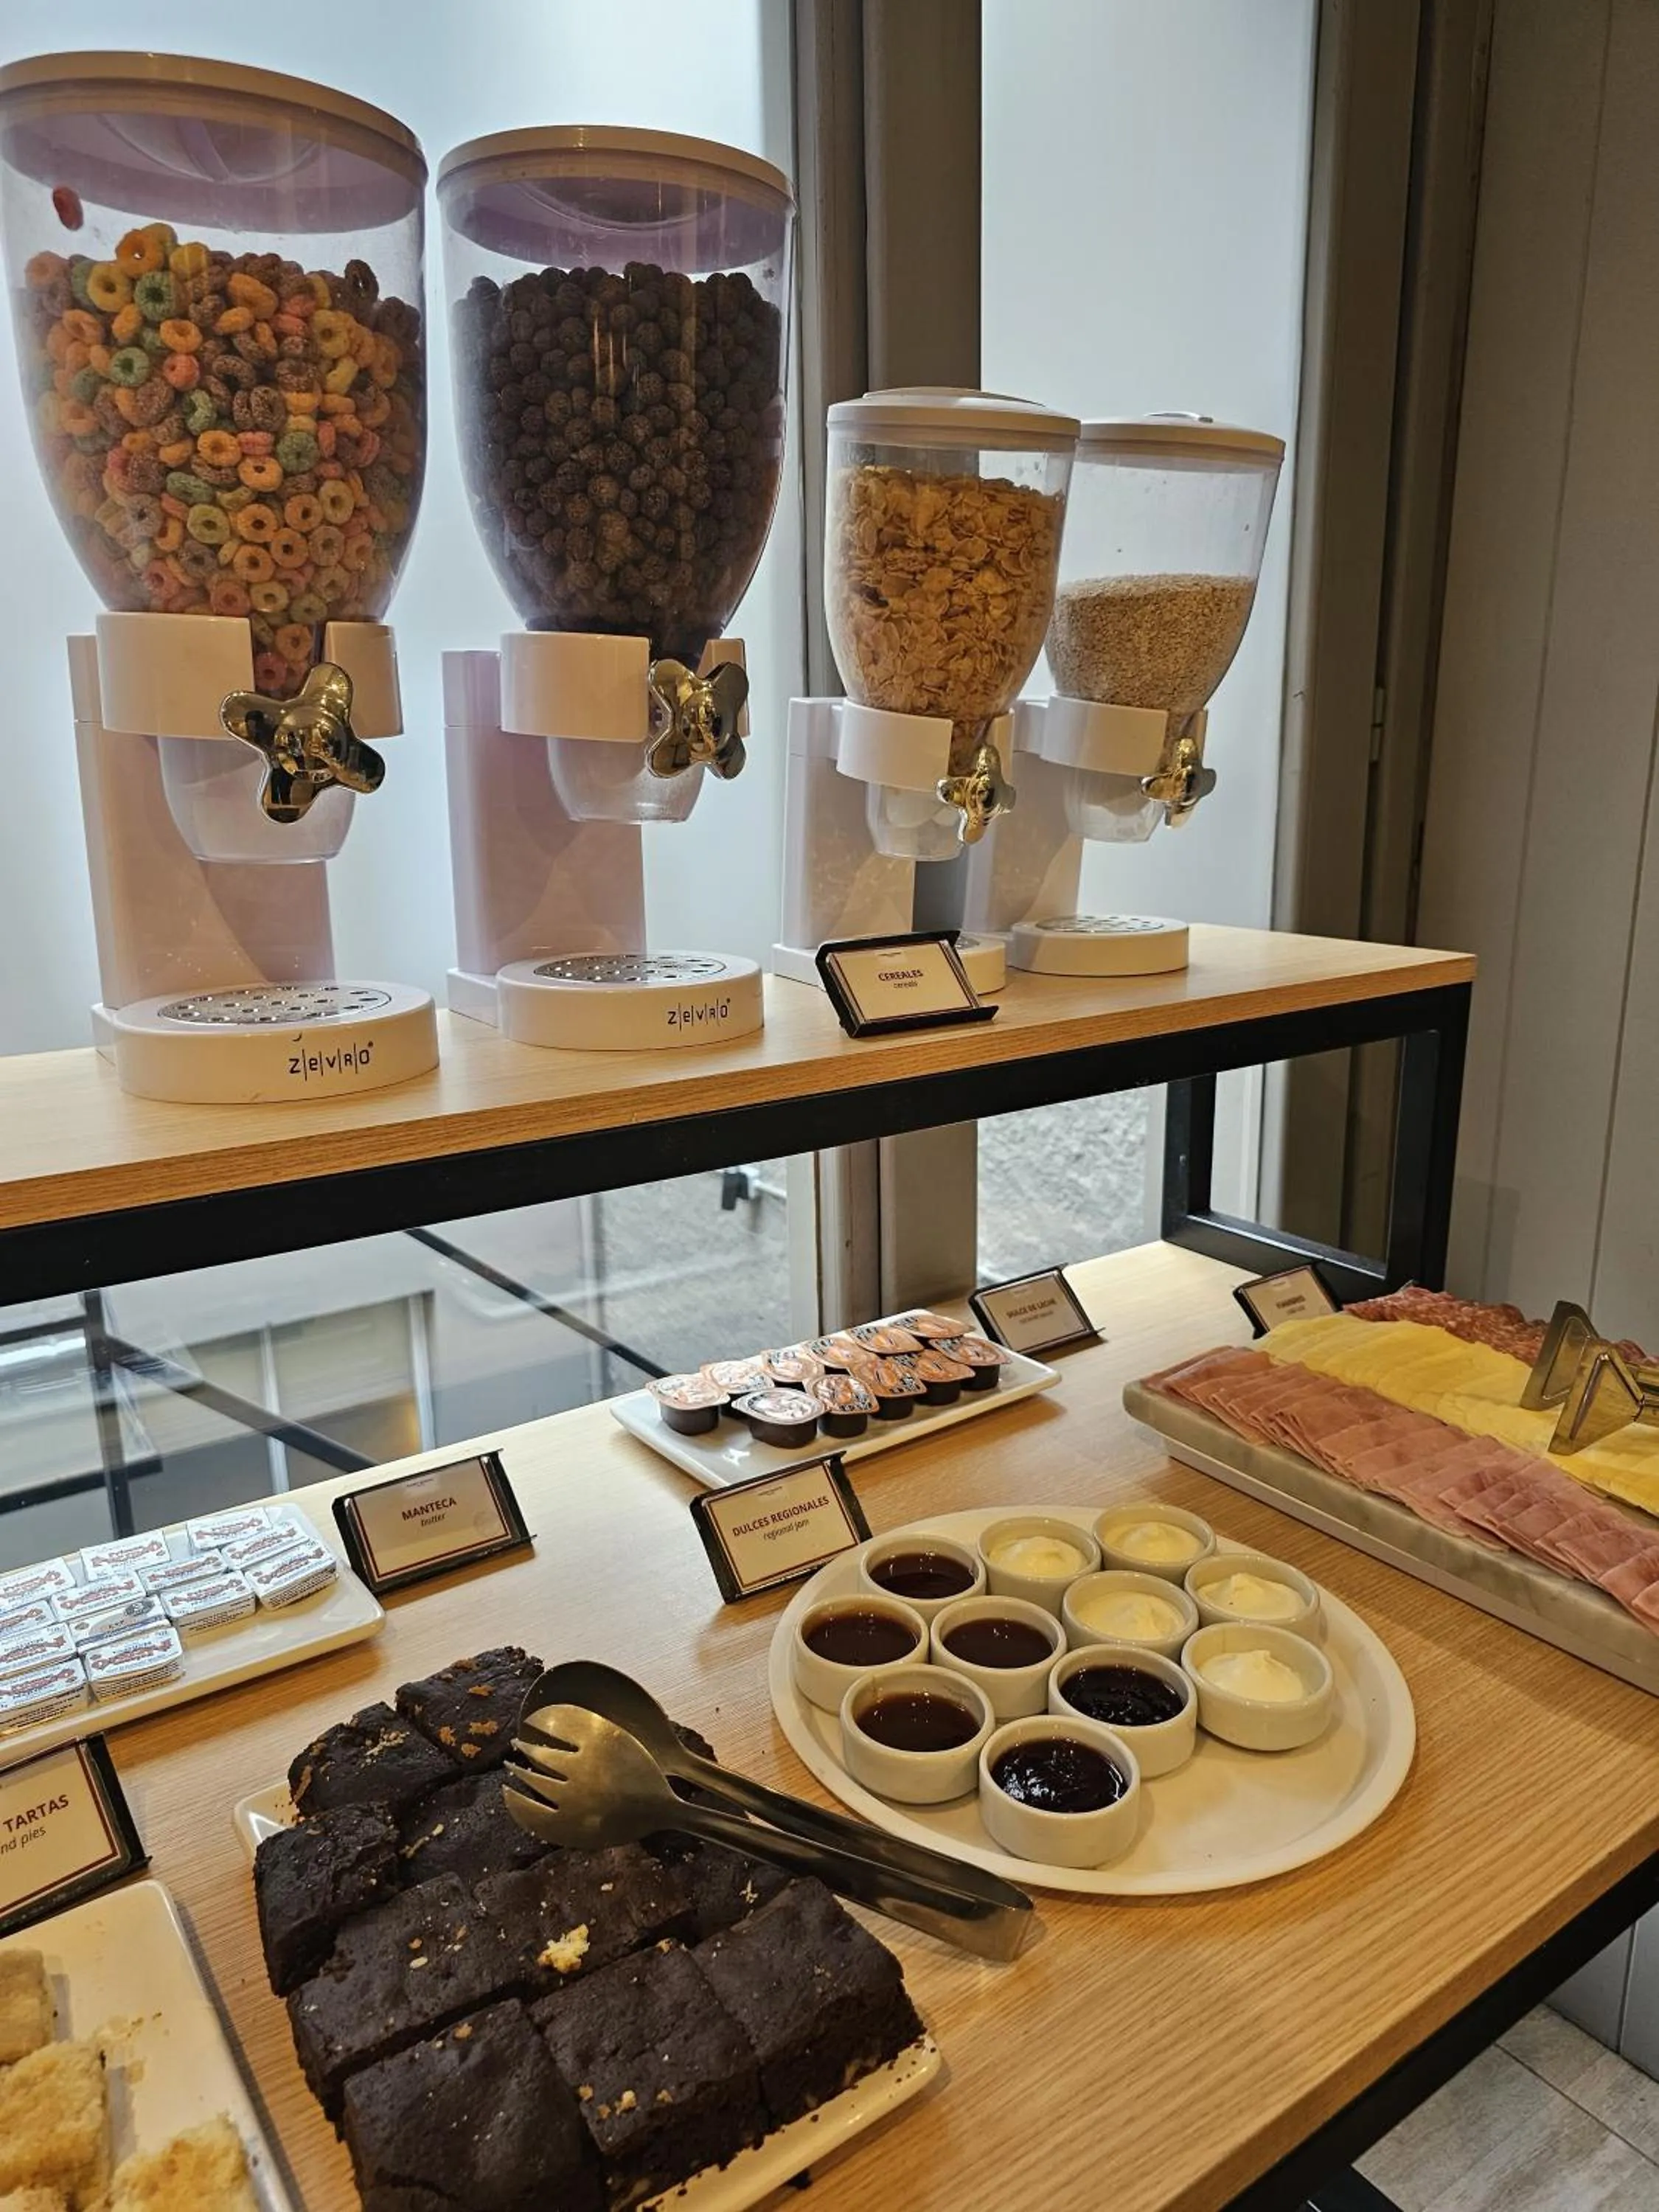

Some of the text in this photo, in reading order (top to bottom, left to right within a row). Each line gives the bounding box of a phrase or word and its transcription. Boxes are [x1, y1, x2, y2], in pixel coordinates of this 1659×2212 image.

[878, 969, 923, 981] CEREALES
[401, 1497, 457, 1521] MANTECA
[420, 1512, 447, 1528] butter
[732, 1495, 830, 1537] DULCES REGIONALES
[763, 1518, 810, 1541] regional jam
[2, 1794, 69, 1833] TARTAS
[0, 1826, 46, 1855] nd pies
